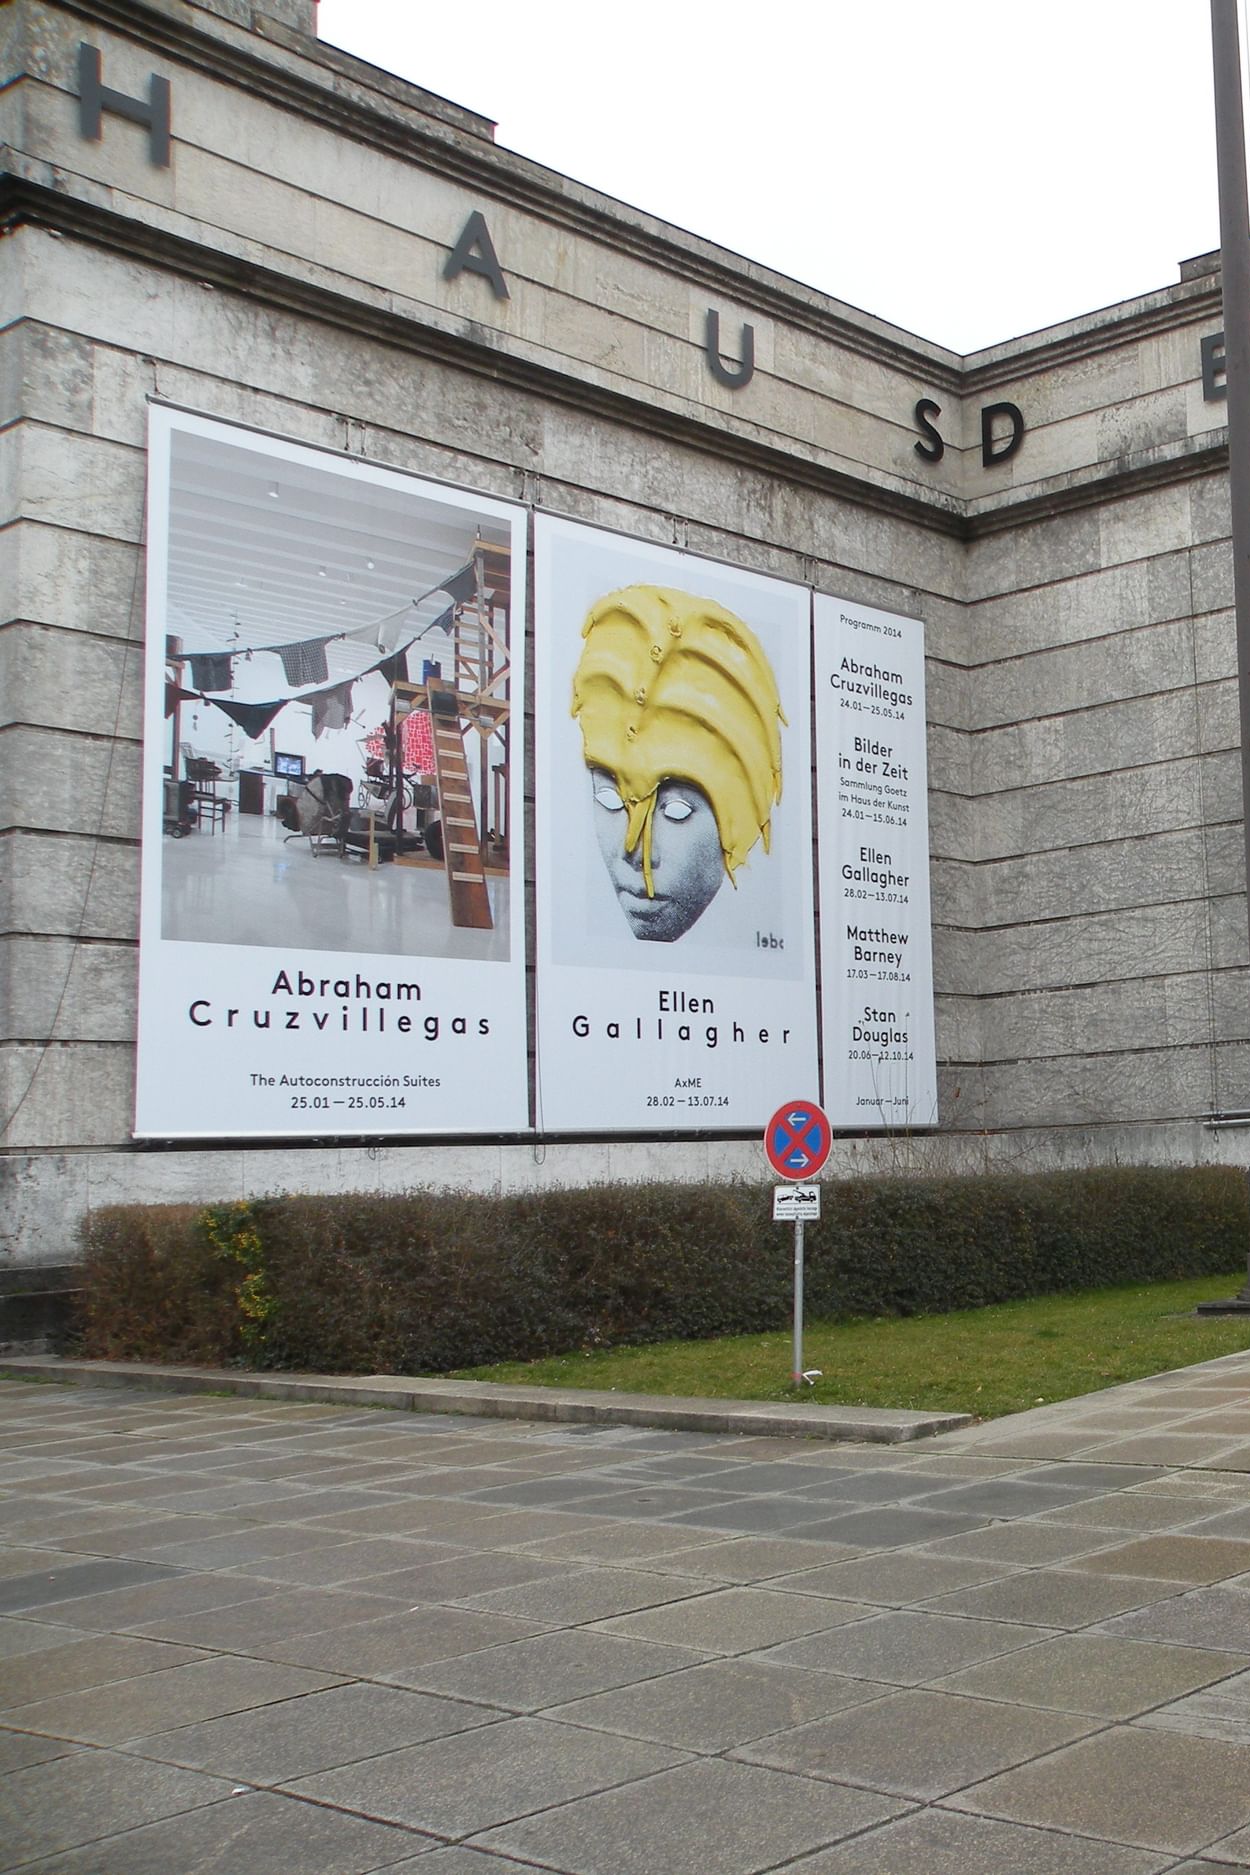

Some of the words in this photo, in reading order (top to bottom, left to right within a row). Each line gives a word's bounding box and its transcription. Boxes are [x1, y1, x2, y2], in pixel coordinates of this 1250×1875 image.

[839, 614, 881, 633] Programm
[883, 626, 902, 638] 2014
[840, 657, 903, 685] Abraham
[830, 674, 913, 706] Cruzvillegas
[854, 737, 893, 759] Bilder
[838, 753, 851, 770] in
[855, 758, 877, 775] der
[882, 762, 909, 780] Zeit
[840, 777, 882, 796] Sammlung
[884, 785, 908, 797] Goetz
[838, 792, 849, 803] im
[851, 794, 871, 806] Haus
[872, 799, 886, 809] der
[887, 801, 910, 813] Kunst
[860, 847, 892, 865] Ellen
[842, 865, 910, 889] Gallagher
[847, 925, 909, 945] Matthew
[854, 946, 902, 968] Barney
[271, 971, 422, 1001] Abraham
[658, 991, 715, 1014] Ellen
[189, 1000, 490, 1041] Cruzvillegas
[864, 1007, 896, 1023] Stan
[572, 1016, 790, 1048] Gallagher
[852, 1027, 908, 1047] Douglas
[250, 1074, 276, 1087] The
[279, 1074, 400, 1088] Autoconstrucción
[403, 1075, 441, 1088] Suites
[674, 1078, 702, 1088] AxME
